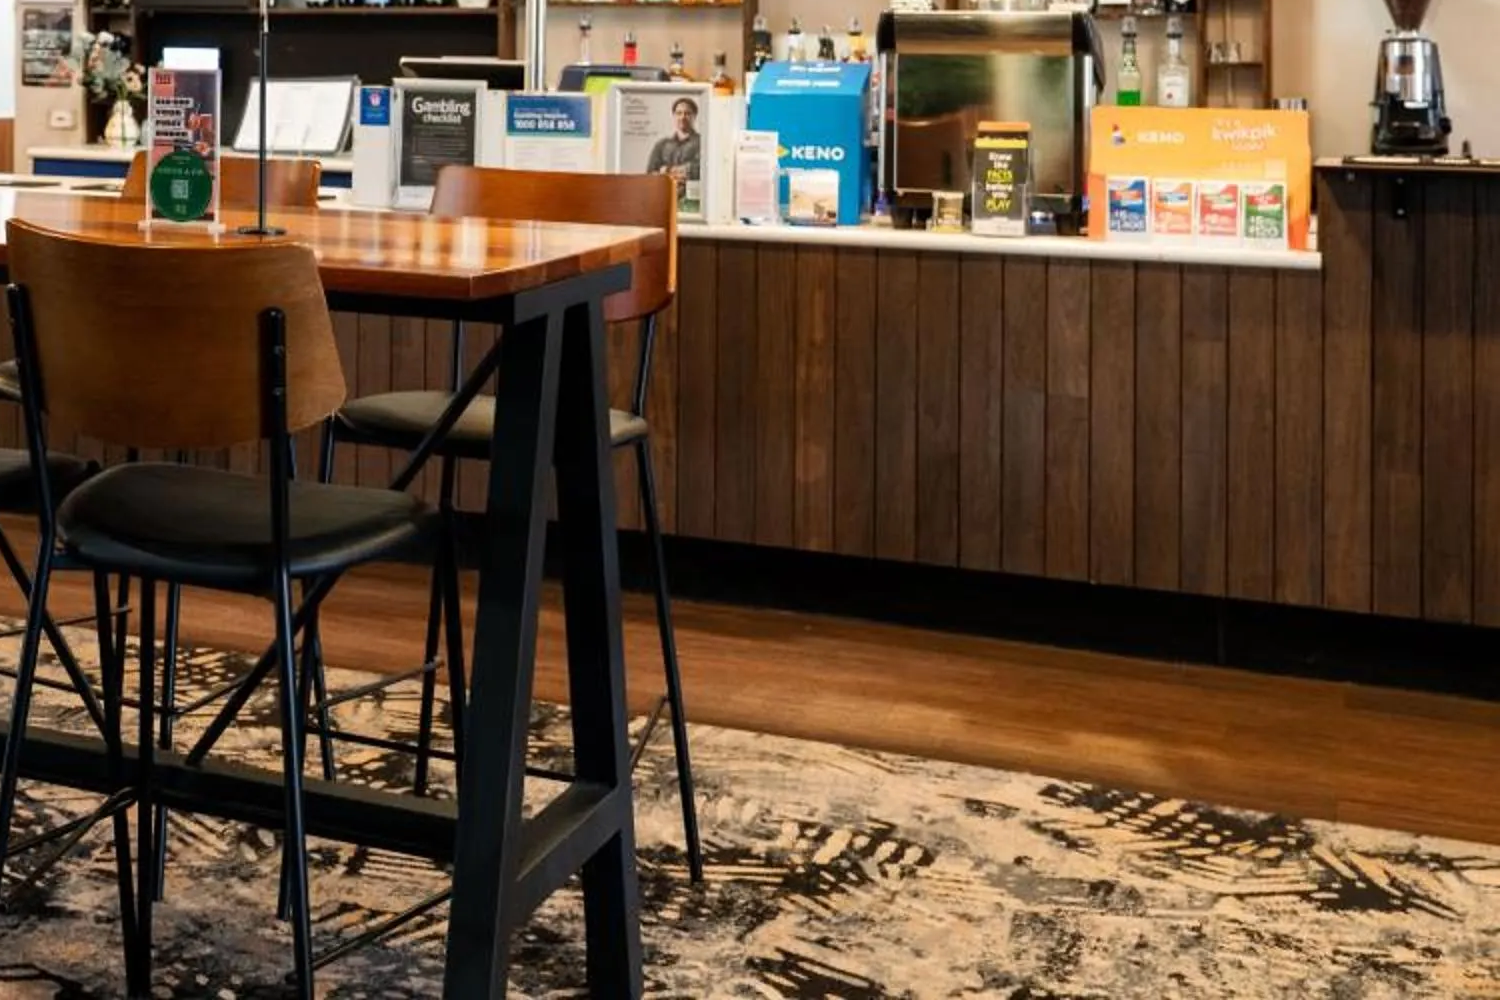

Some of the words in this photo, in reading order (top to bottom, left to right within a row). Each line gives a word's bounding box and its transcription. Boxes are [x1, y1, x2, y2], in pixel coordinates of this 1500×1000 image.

[411, 96, 471, 117] Gambling
[1137, 131, 1185, 144] KENO
[791, 145, 845, 161] KENO
